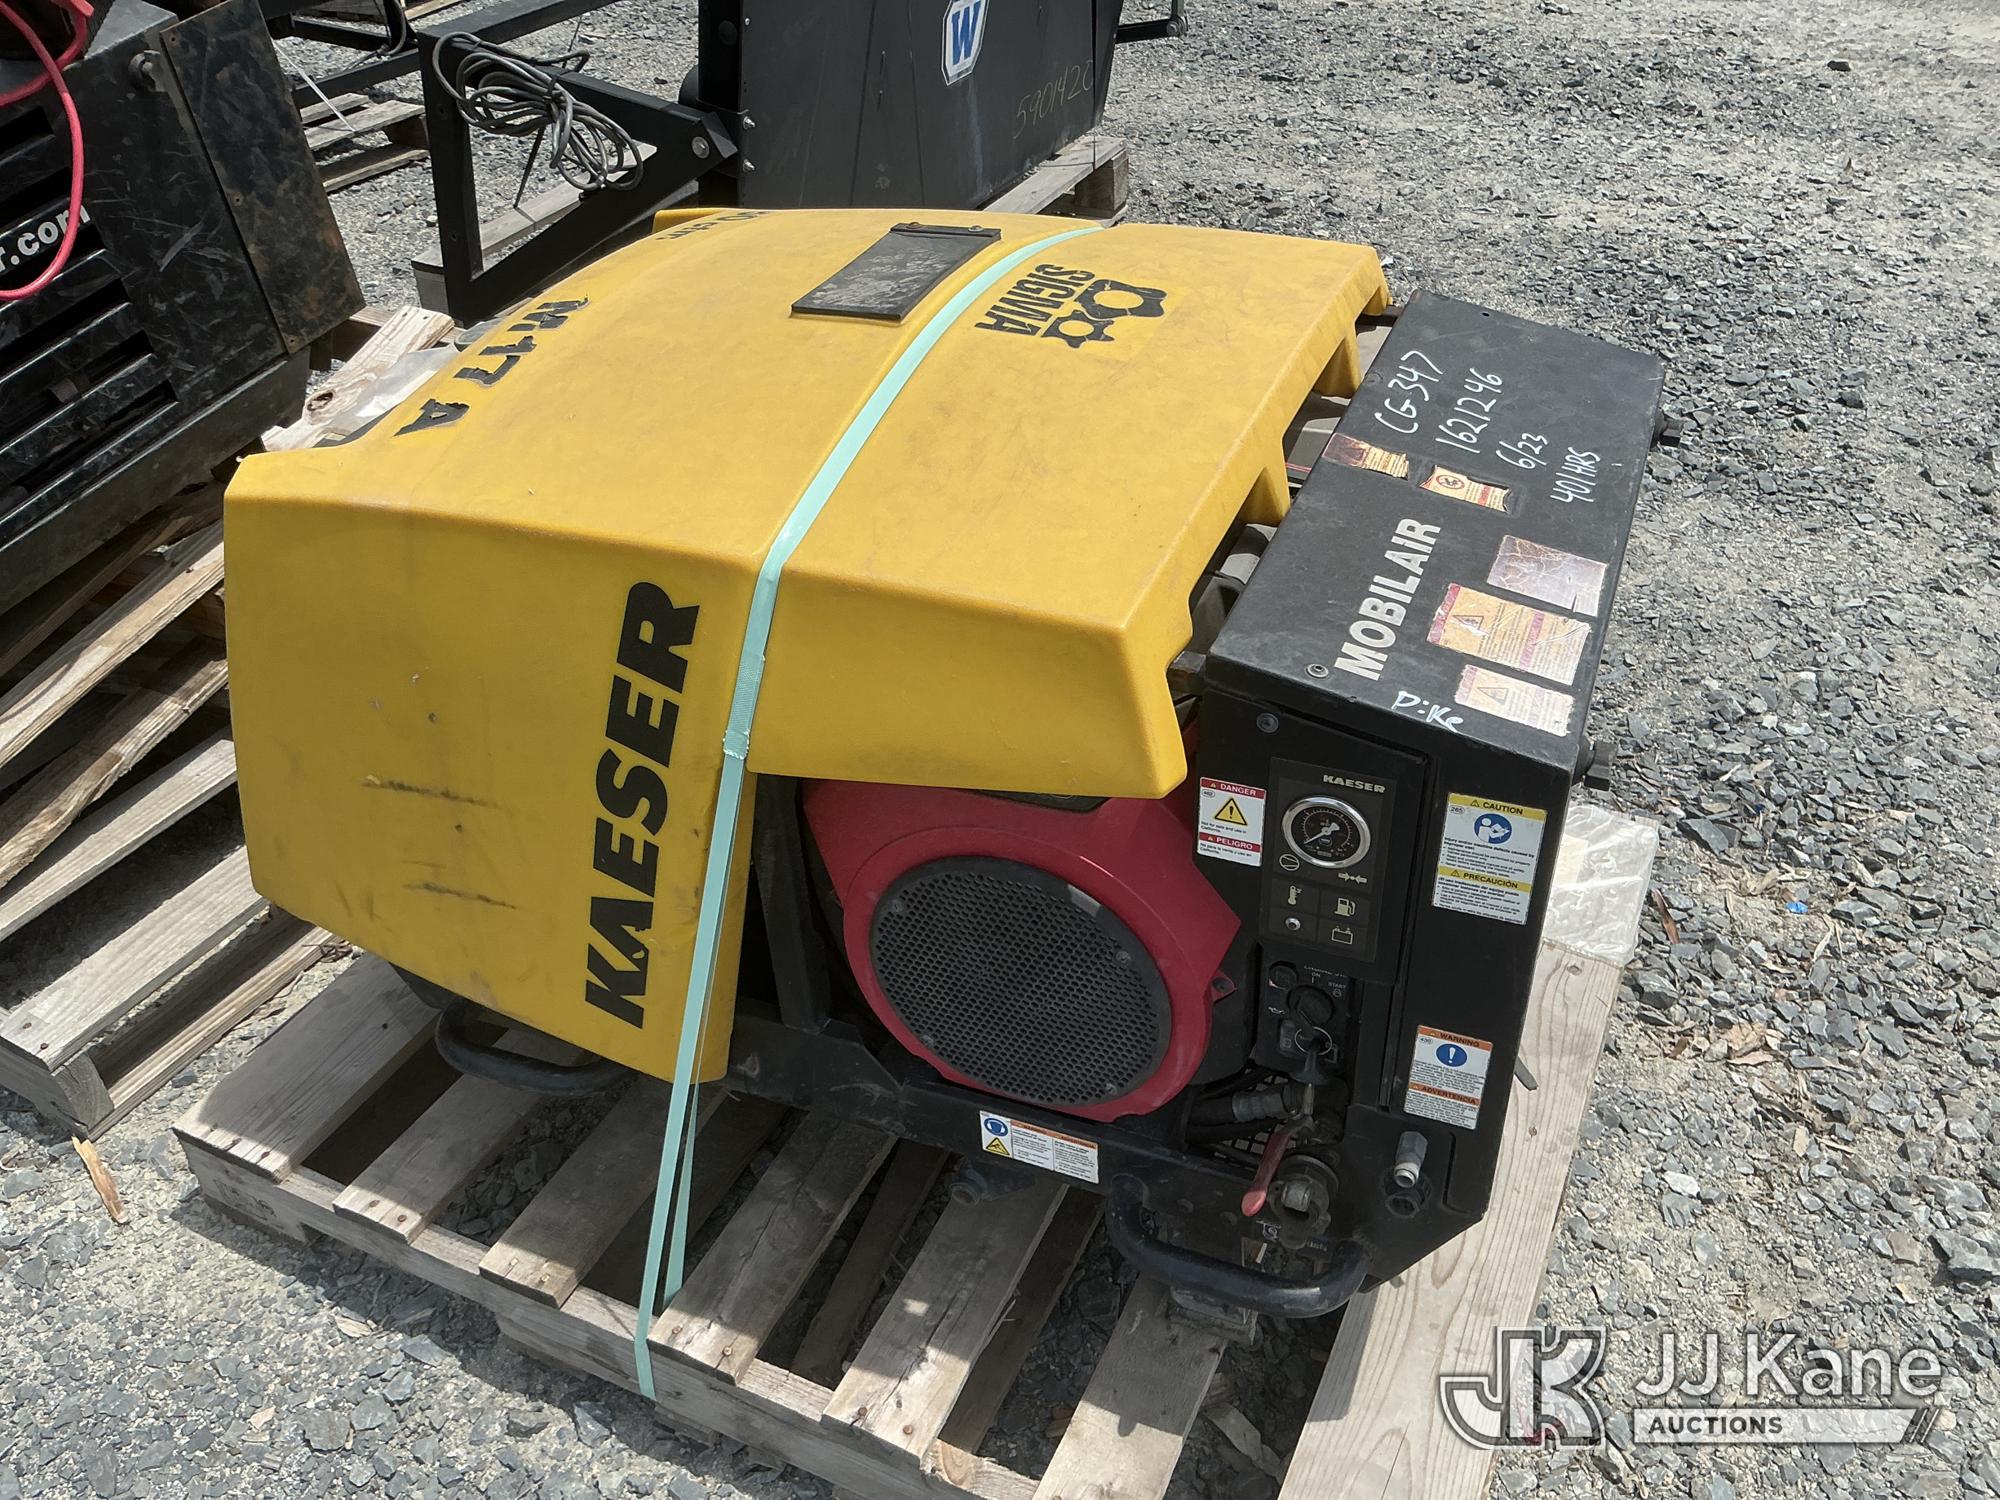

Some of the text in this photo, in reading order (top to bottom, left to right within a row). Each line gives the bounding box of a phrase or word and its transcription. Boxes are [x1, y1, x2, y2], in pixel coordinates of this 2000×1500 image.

[974, 263, 1096, 336] SIGMA
[1435, 367, 1503, 453] 1621246
[1495, 432, 1548, 470] 6/23
[1334, 518, 1441, 682] MOBILAIR
[1220, 783, 1257, 797] DANGER
[1322, 774, 1386, 794] KAESER
[584, 581, 700, 1029] KAESER
[1482, 801, 1524, 815] CAUTION
[1216, 836, 1253, 850] PELIGRO
[1463, 872, 1519, 889] PRECAUCIÓN
[1439, 1032, 1480, 1048] WARNING
[1421, 1085, 1476, 1104] ADVERTENCIA
